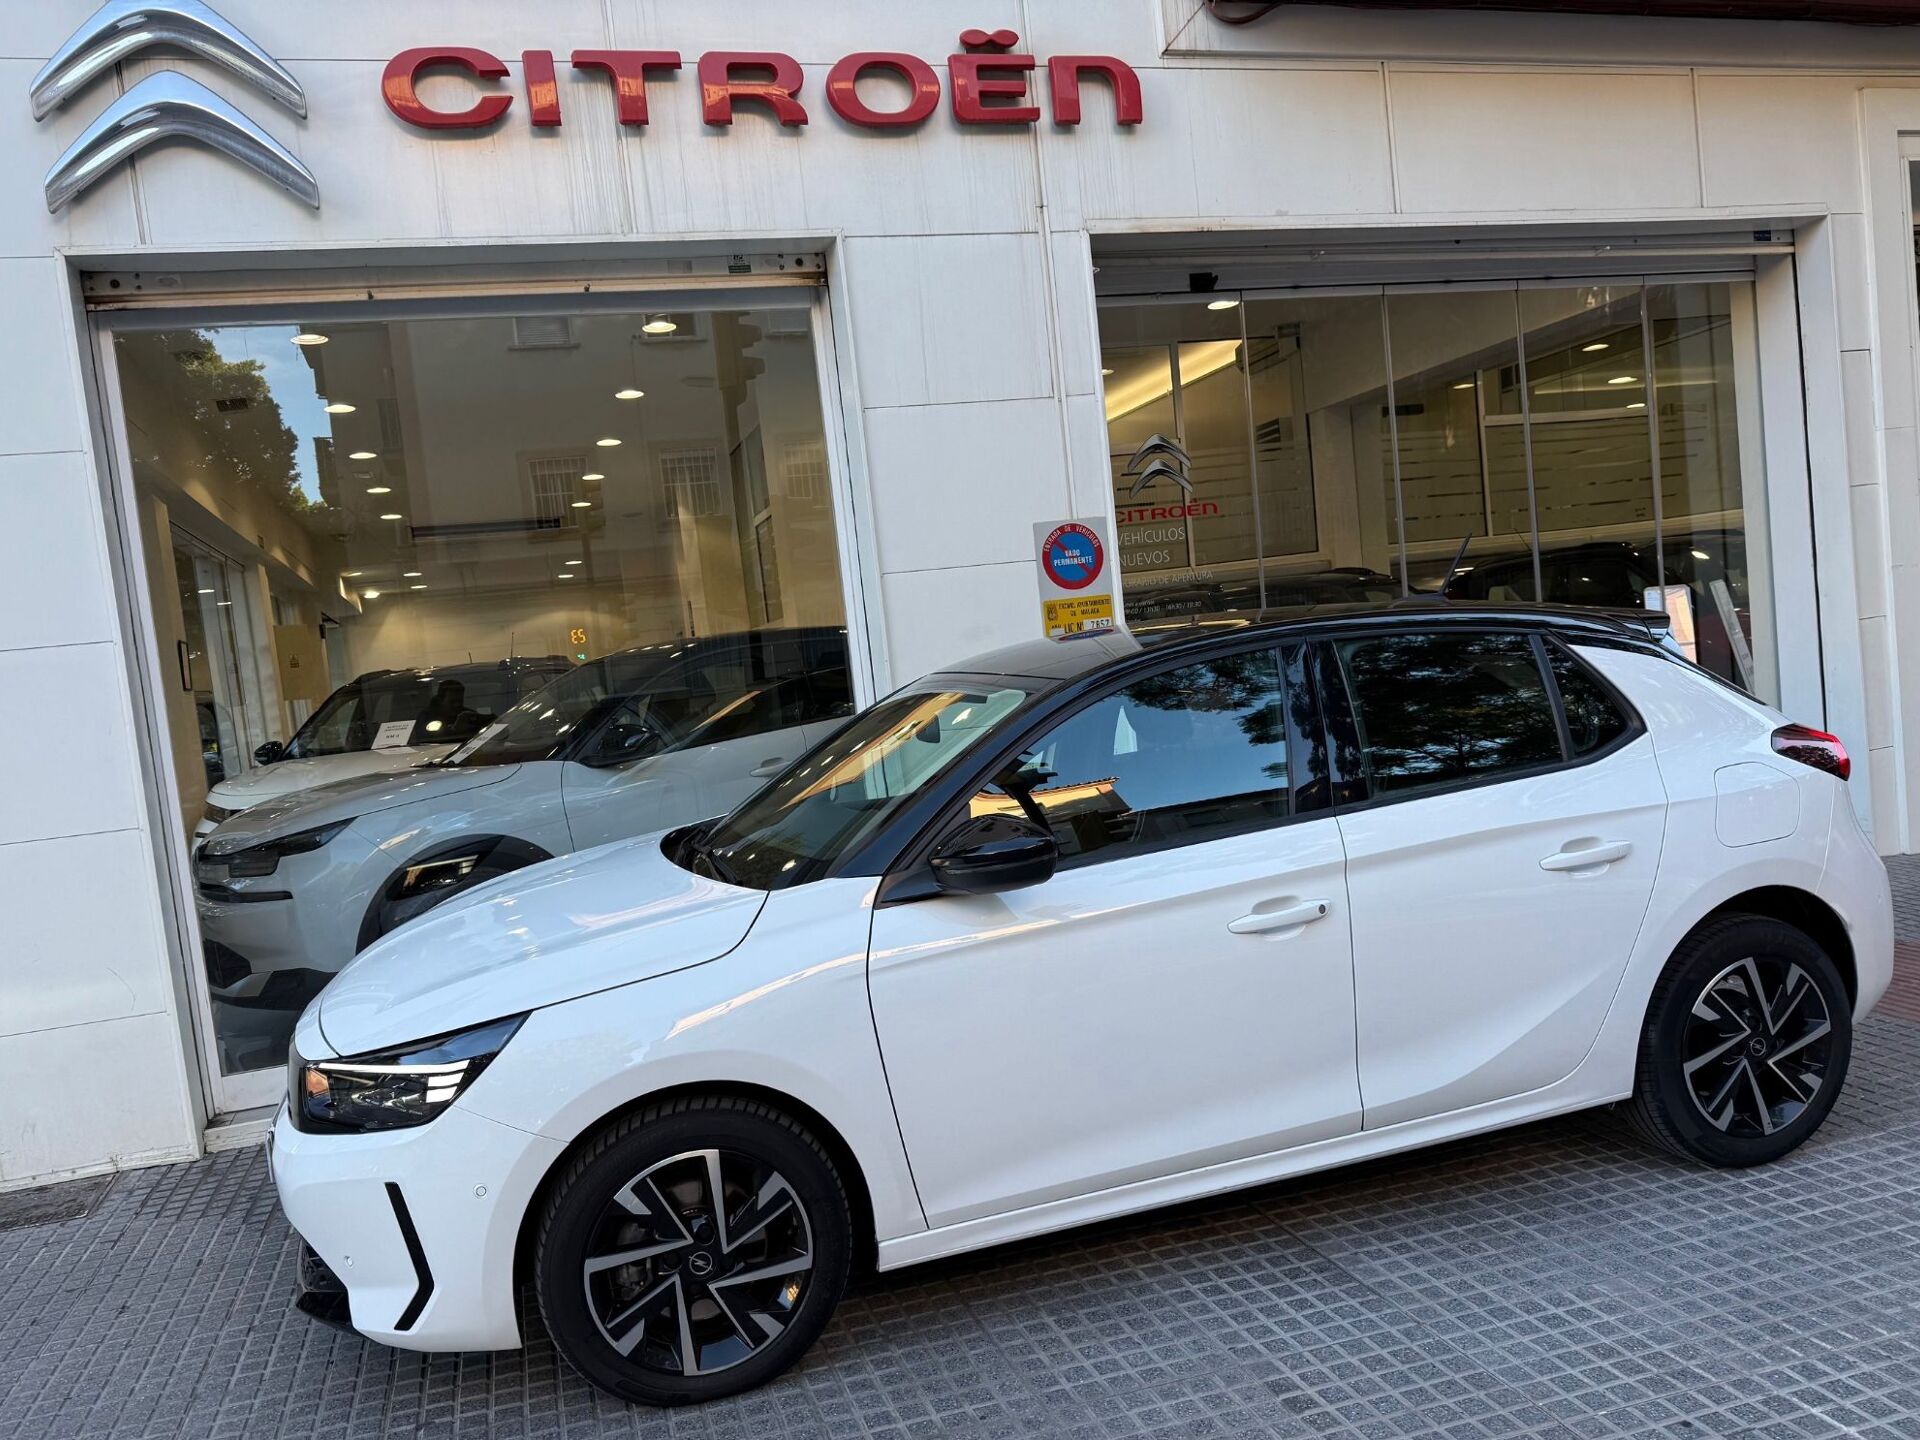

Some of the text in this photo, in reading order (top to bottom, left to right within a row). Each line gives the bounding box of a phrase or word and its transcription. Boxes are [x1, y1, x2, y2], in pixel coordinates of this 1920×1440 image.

[381, 28, 1143, 128] CITROËN
[1043, 530, 1061, 552] ENTRADA
[1064, 549, 1081, 557] VADO
[1053, 555, 1093, 567] PERMANENTE
[1158, 575, 1169, 585] DE
[1171, 570, 1214, 584] APERTURA
